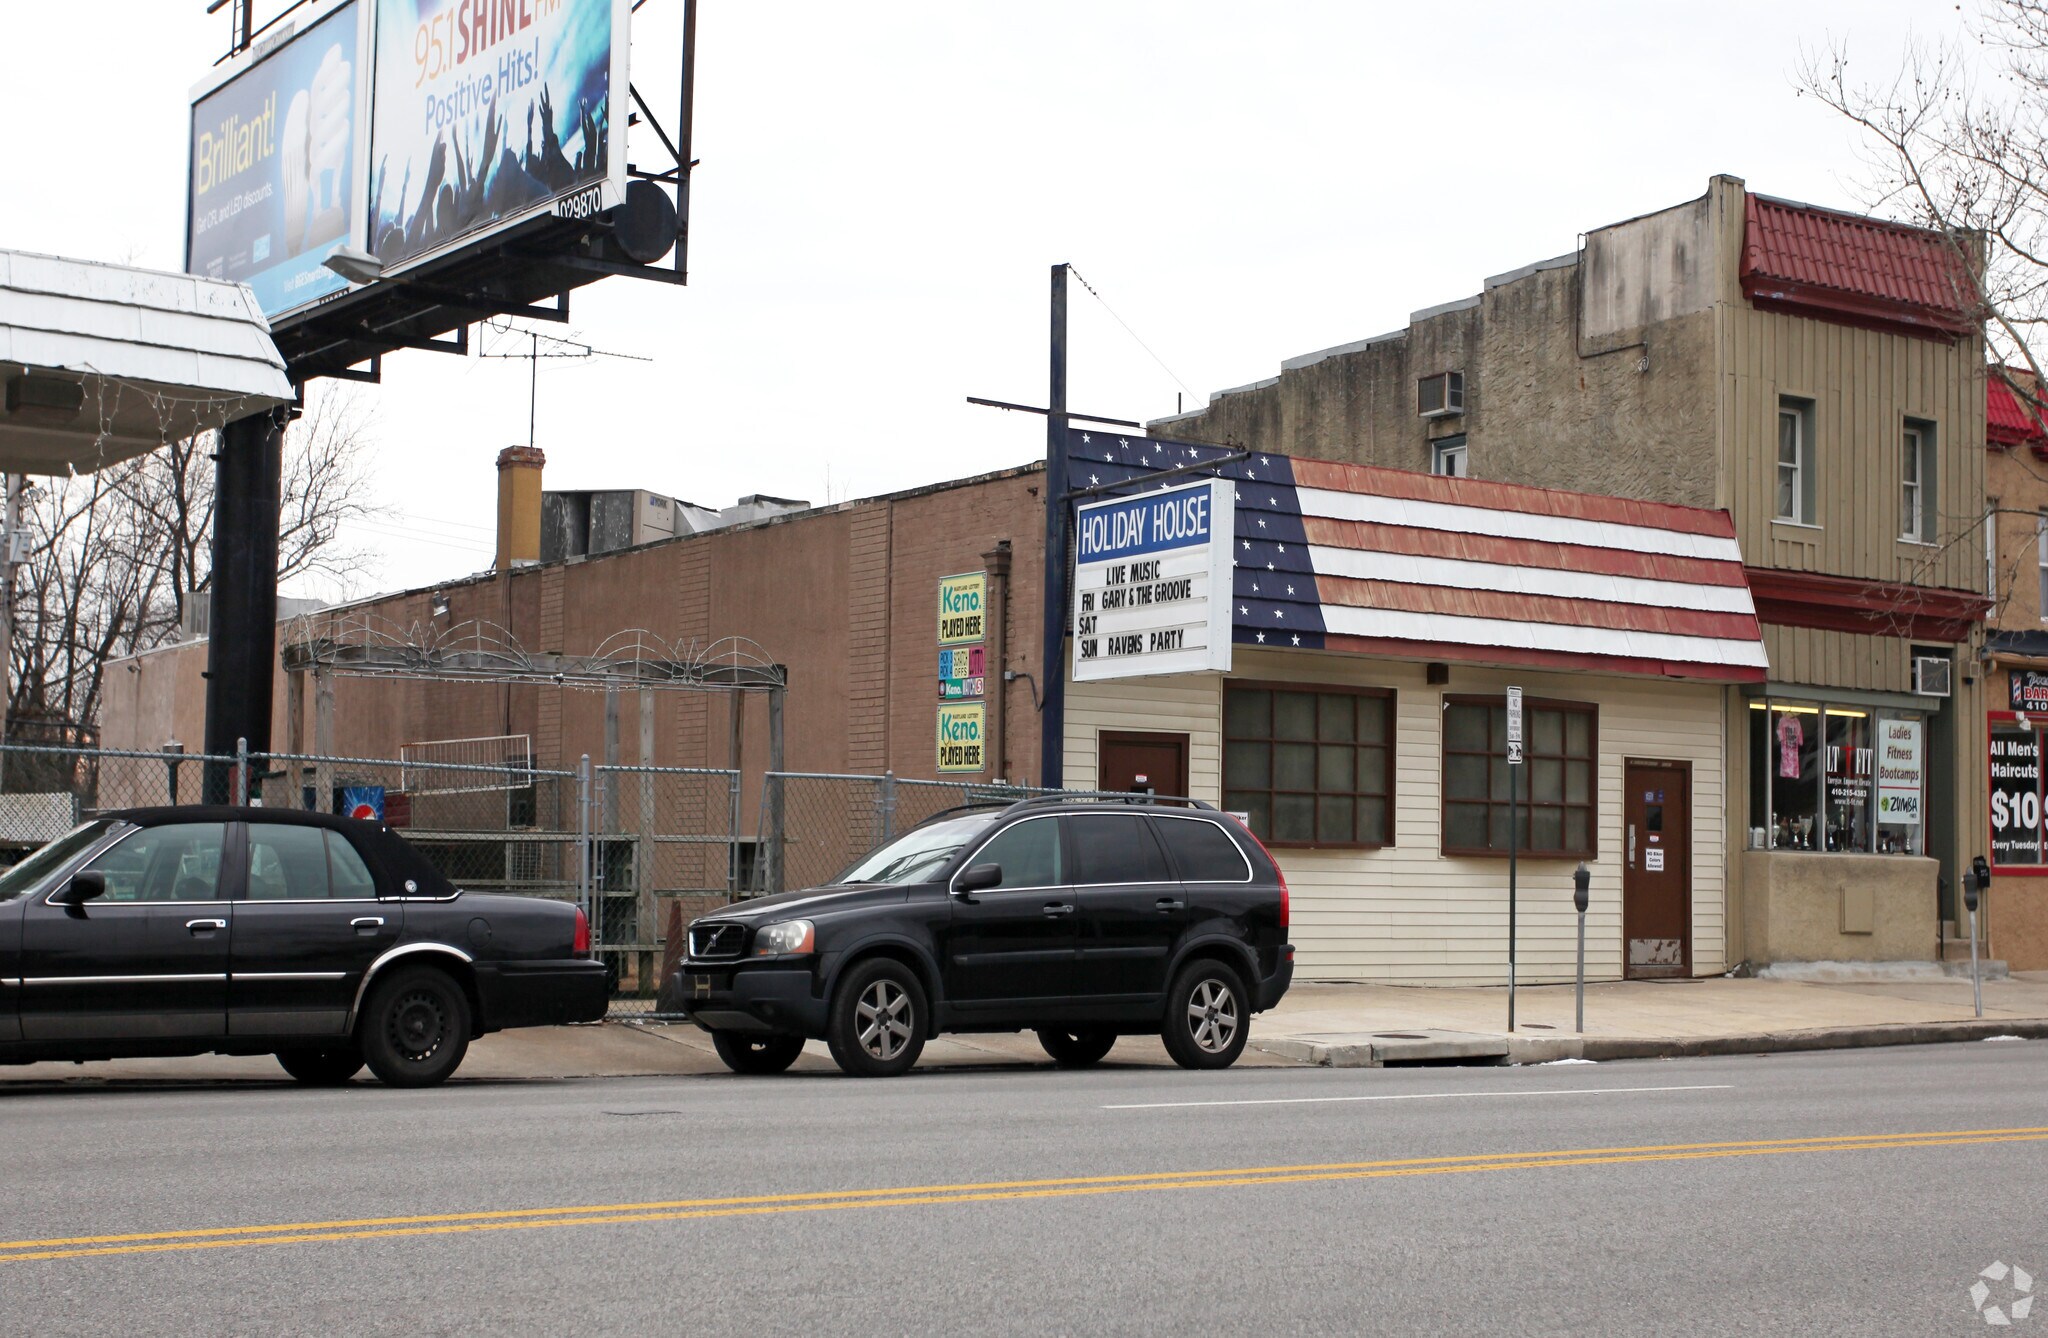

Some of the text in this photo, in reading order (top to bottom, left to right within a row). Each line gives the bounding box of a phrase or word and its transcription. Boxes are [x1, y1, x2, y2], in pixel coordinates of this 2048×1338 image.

[415, 7, 454, 89] 95.1
[425, 36, 539, 135] Positive Hits!
[198, 90, 276, 195] Brilliant!
[218, 201, 230, 223] and
[230, 195, 243, 216] LED
[560, 187, 601, 219] 029870
[1082, 494, 1209, 555] HOLIDAY HOUSE
[1106, 560, 1161, 586] LIVE MUSIC
[1082, 579, 1191, 612] FRI GARY & THE GROOVE
[942, 616, 981, 639] PLAYED HERE
[1079, 616, 1097, 635] SAT
[1081, 629, 1184, 658] SUN RAVENS PARTY
[954, 667, 967, 677] OFFS
[2026, 701, 2047, 711] 410
[1888, 725, 1912, 740] Ladies
[941, 745, 980, 766] PLAYED HERE
[1887, 746, 1912, 760] Fitness
[1990, 741, 2039, 757] All Men's
[1827, 746, 1873, 775] LT FIT
[1991, 762, 2039, 779] Haircuts
[1880, 766, 1919, 783] Bootcamps
[1831, 788, 1867, 798] 410-215-4383
[1890, 796, 1918, 813] ZUMBA
[1991, 788, 2039, 832] $10
[1992, 840, 2010, 851] Every
[2011, 840, 2041, 851] Tuesday!
